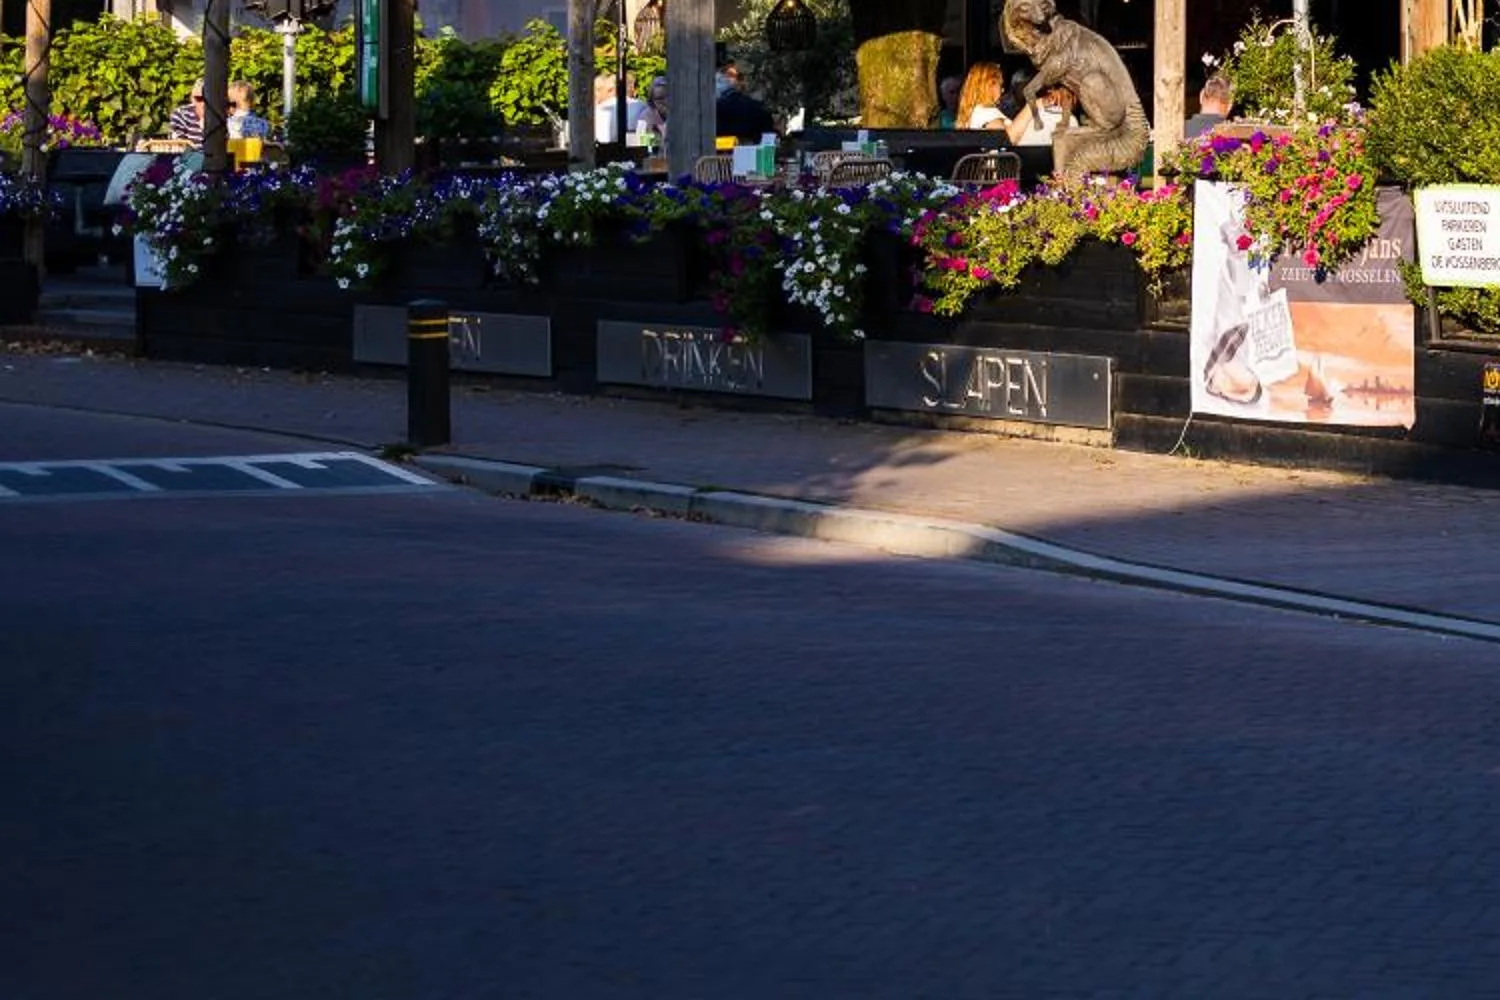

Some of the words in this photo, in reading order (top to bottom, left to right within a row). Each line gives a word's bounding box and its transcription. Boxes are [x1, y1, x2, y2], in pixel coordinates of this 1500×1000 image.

[1441, 219, 1487, 233] PARKEREN
[1447, 237, 1483, 251] GASTEN
[1431, 255, 1443, 269] DE
[642, 329, 764, 388] DRINKEN
[921, 352, 1048, 417] SLAPEN
